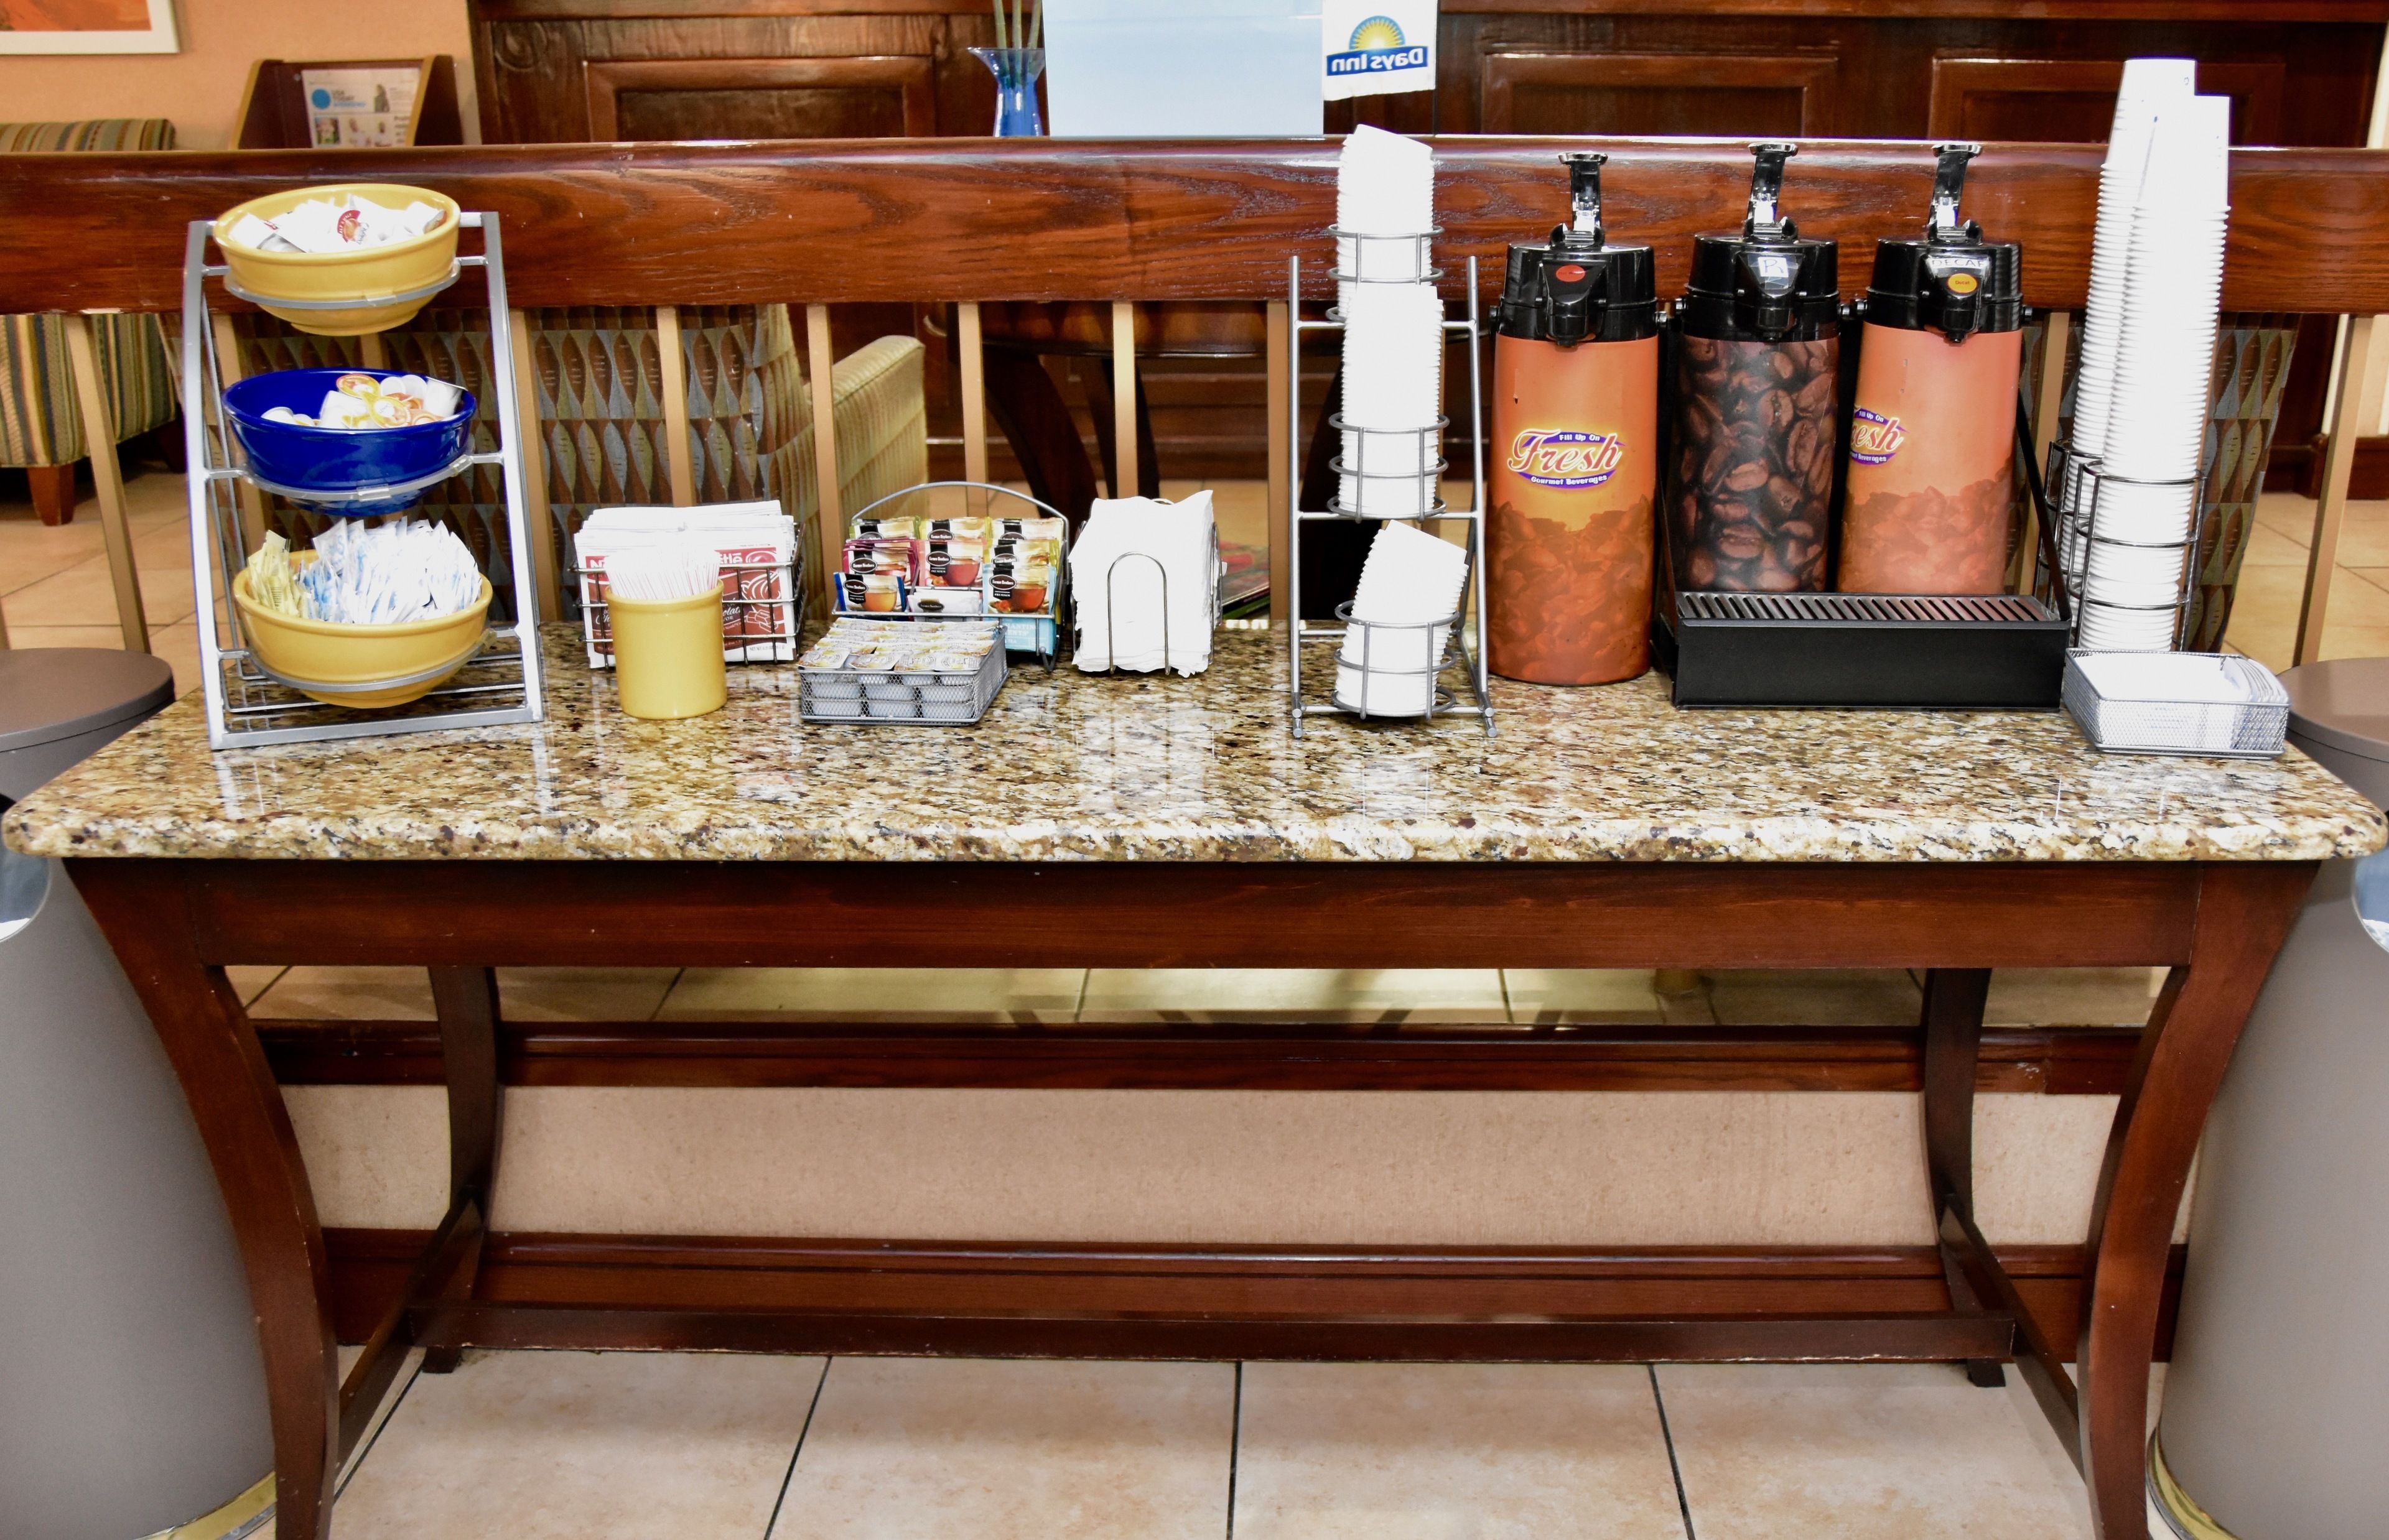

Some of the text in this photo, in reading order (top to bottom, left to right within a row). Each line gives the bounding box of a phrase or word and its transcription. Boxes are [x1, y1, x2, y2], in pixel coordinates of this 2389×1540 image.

[1763, 259, 1784, 274] R
[1932, 259, 1985, 267] DECAF
[1866, 412, 1874, 420] Up
[1875, 414, 1884, 423] On
[1575, 434, 1586, 442] Up
[1507, 428, 1623, 473] Fresh
[1858, 453, 1887, 463] Beverages
[1530, 475, 1608, 485] Gourmet Beverages
